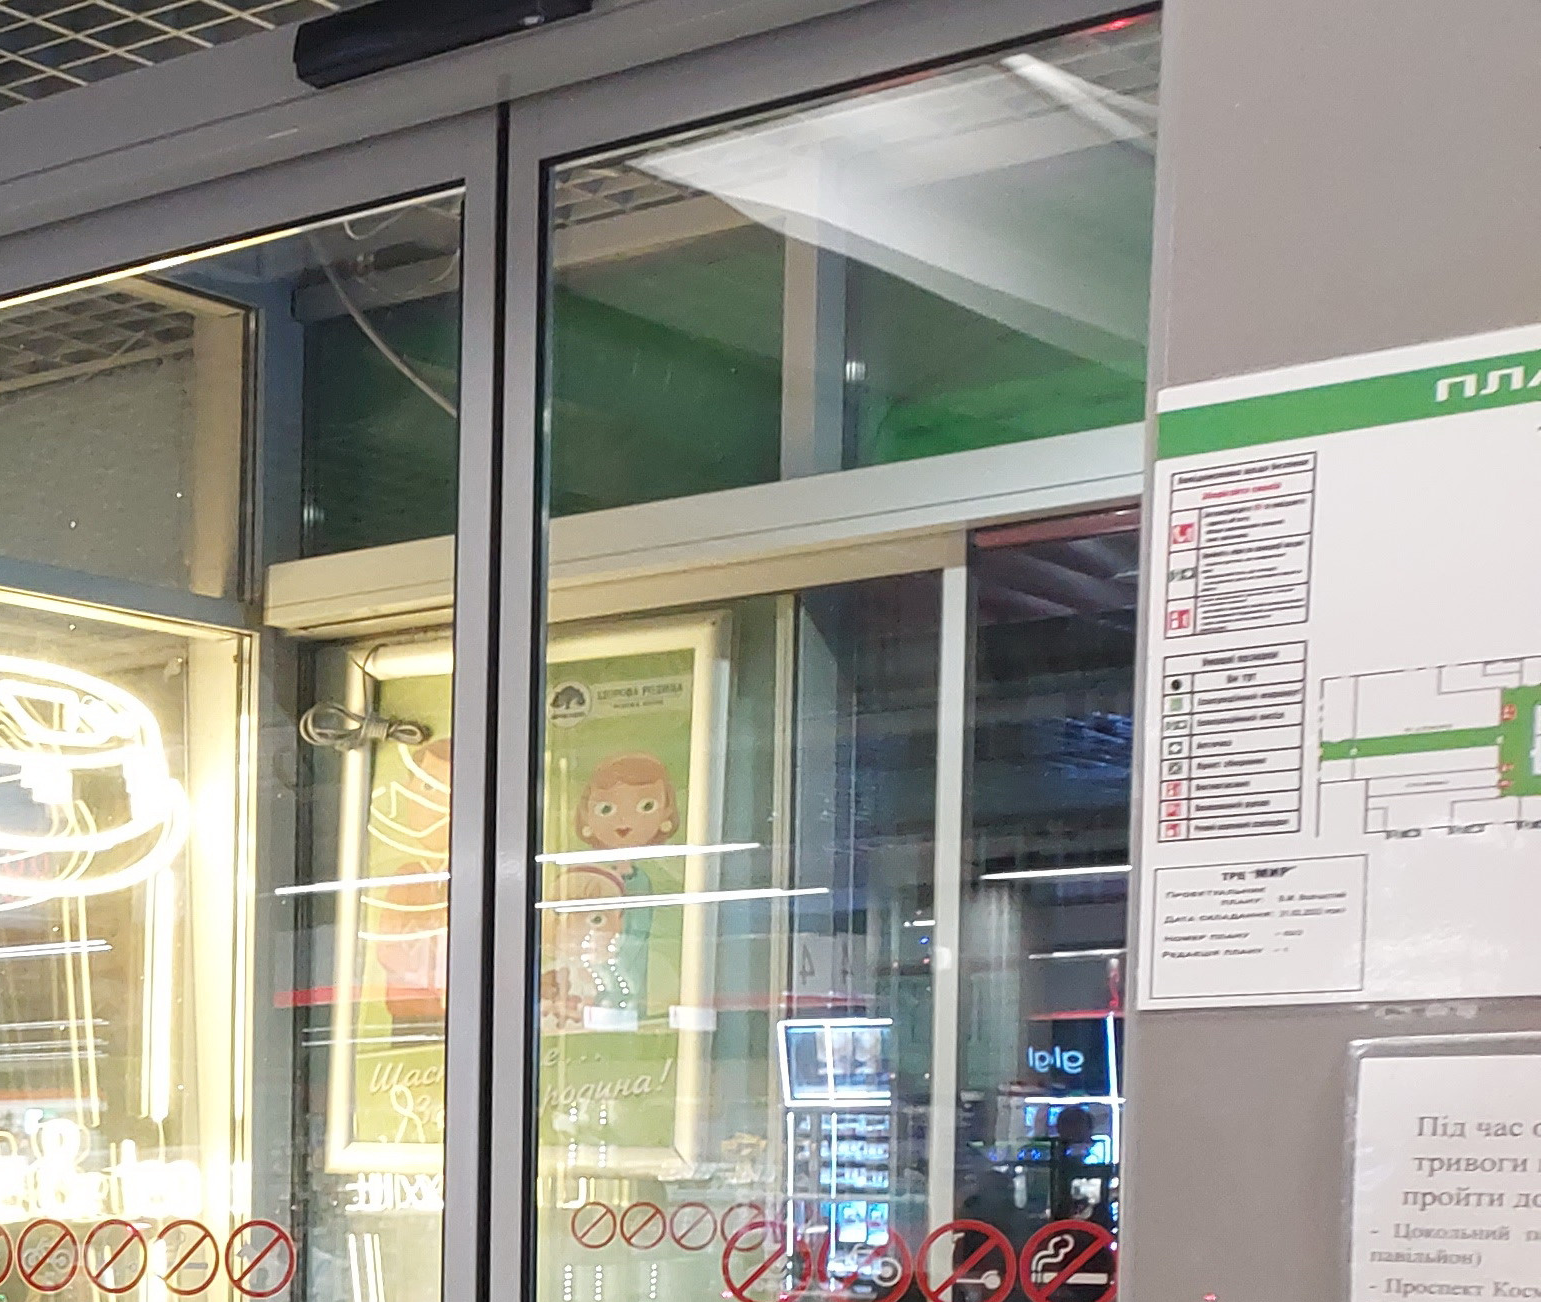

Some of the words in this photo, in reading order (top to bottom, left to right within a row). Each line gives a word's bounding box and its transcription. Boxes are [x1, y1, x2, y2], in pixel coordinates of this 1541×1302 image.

[1434, 365, 1541, 403] ПЛ
[1416, 1115, 1466, 1138] Під
[1476, 1120, 1523, 1138] час
[1414, 1156, 1528, 1178] тривоги
[1401, 1187, 1505, 1212] пройти
[1392, 1222, 1510, 1243] Цокольний
[1384, 1278, 1485, 1299] Проспект
